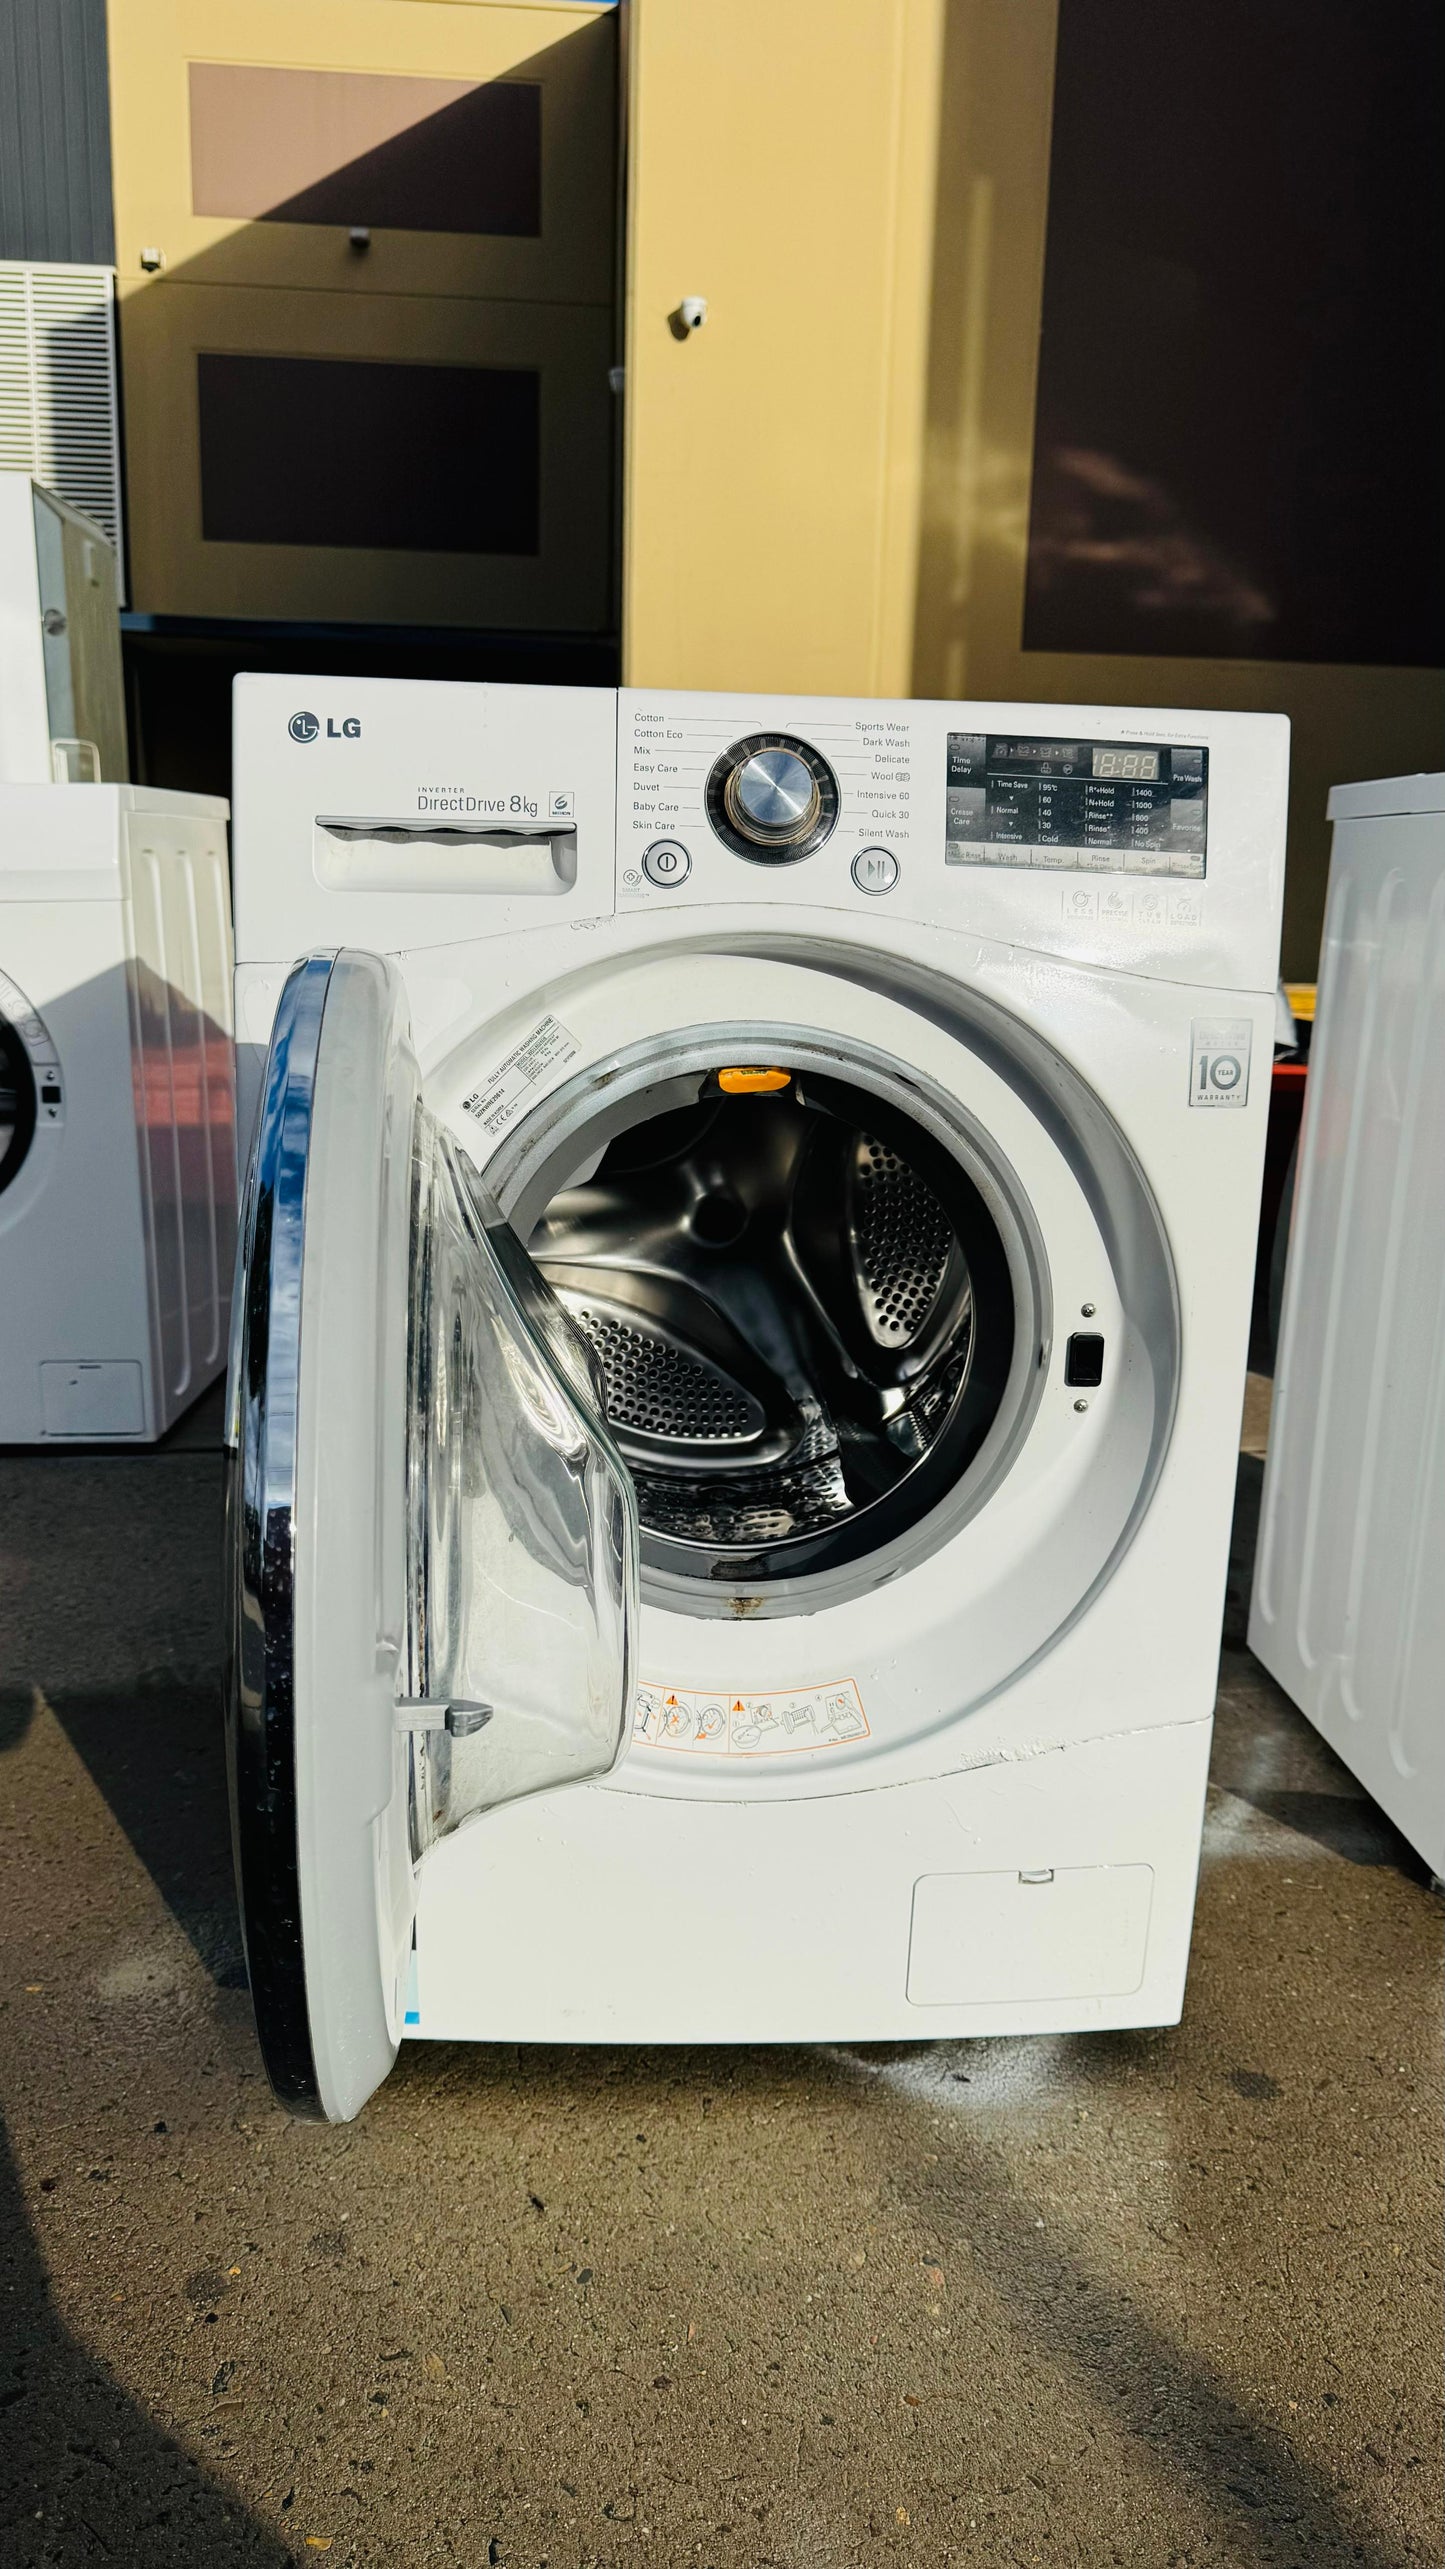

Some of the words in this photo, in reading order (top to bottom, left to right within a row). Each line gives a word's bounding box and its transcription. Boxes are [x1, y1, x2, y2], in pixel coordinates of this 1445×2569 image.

[634, 714, 664, 722] Cotton
[326, 717, 362, 738] LG
[855, 722, 884, 732] Sports
[887, 724, 909, 732] Wear
[634, 730, 663, 738] Cotton
[664, 730, 683, 739] Eco
[863, 738, 882, 746] Dark
[882, 739, 910, 748] Wash
[634, 747, 650, 755] Mix
[875, 755, 910, 764] Delicate
[952, 756, 971, 764] Time
[634, 764, 656, 774] Easy
[658, 764, 678, 773] Care
[952, 765, 971, 774] Delay
[871, 772, 894, 781] Wool
[1185, 775, 1202, 783] Wash
[633, 782, 660, 791] Duvet
[997, 780, 1013, 788] Time
[1014, 781, 1028, 789] Save
[417, 786, 466, 795] INVERTER
[857, 790, 898, 800] Intensive
[899, 792, 910, 800] 60
[509, 795, 539, 818] 8kg
[633, 802, 656, 813] Baby
[657, 804, 679, 812] Care
[996, 806, 1018, 814] Normal
[872, 810, 896, 819] Quick
[898, 810, 910, 819] 30
[950, 808, 973, 816] Crease
[632, 821, 652, 830] Skin
[654, 822, 675, 830] Care
[1172, 824, 1200, 832] Favorite
[858, 828, 882, 838] Silent
[882, 830, 910, 838] Wash
[996, 832, 1022, 840] Intensive
[1042, 835, 1059, 843] Cold
[1145, 840, 1160, 849] Spin
[488, 1070, 501, 1084] FULLY
[499, 1050, 522, 1073] AUTOMATIC
[520, 1033, 538, 1052] WASHING
[536, 1017, 554, 1036] MACHINE
[1199, 1054, 1242, 1090] 10
[470, 1092, 479, 1103] LG
